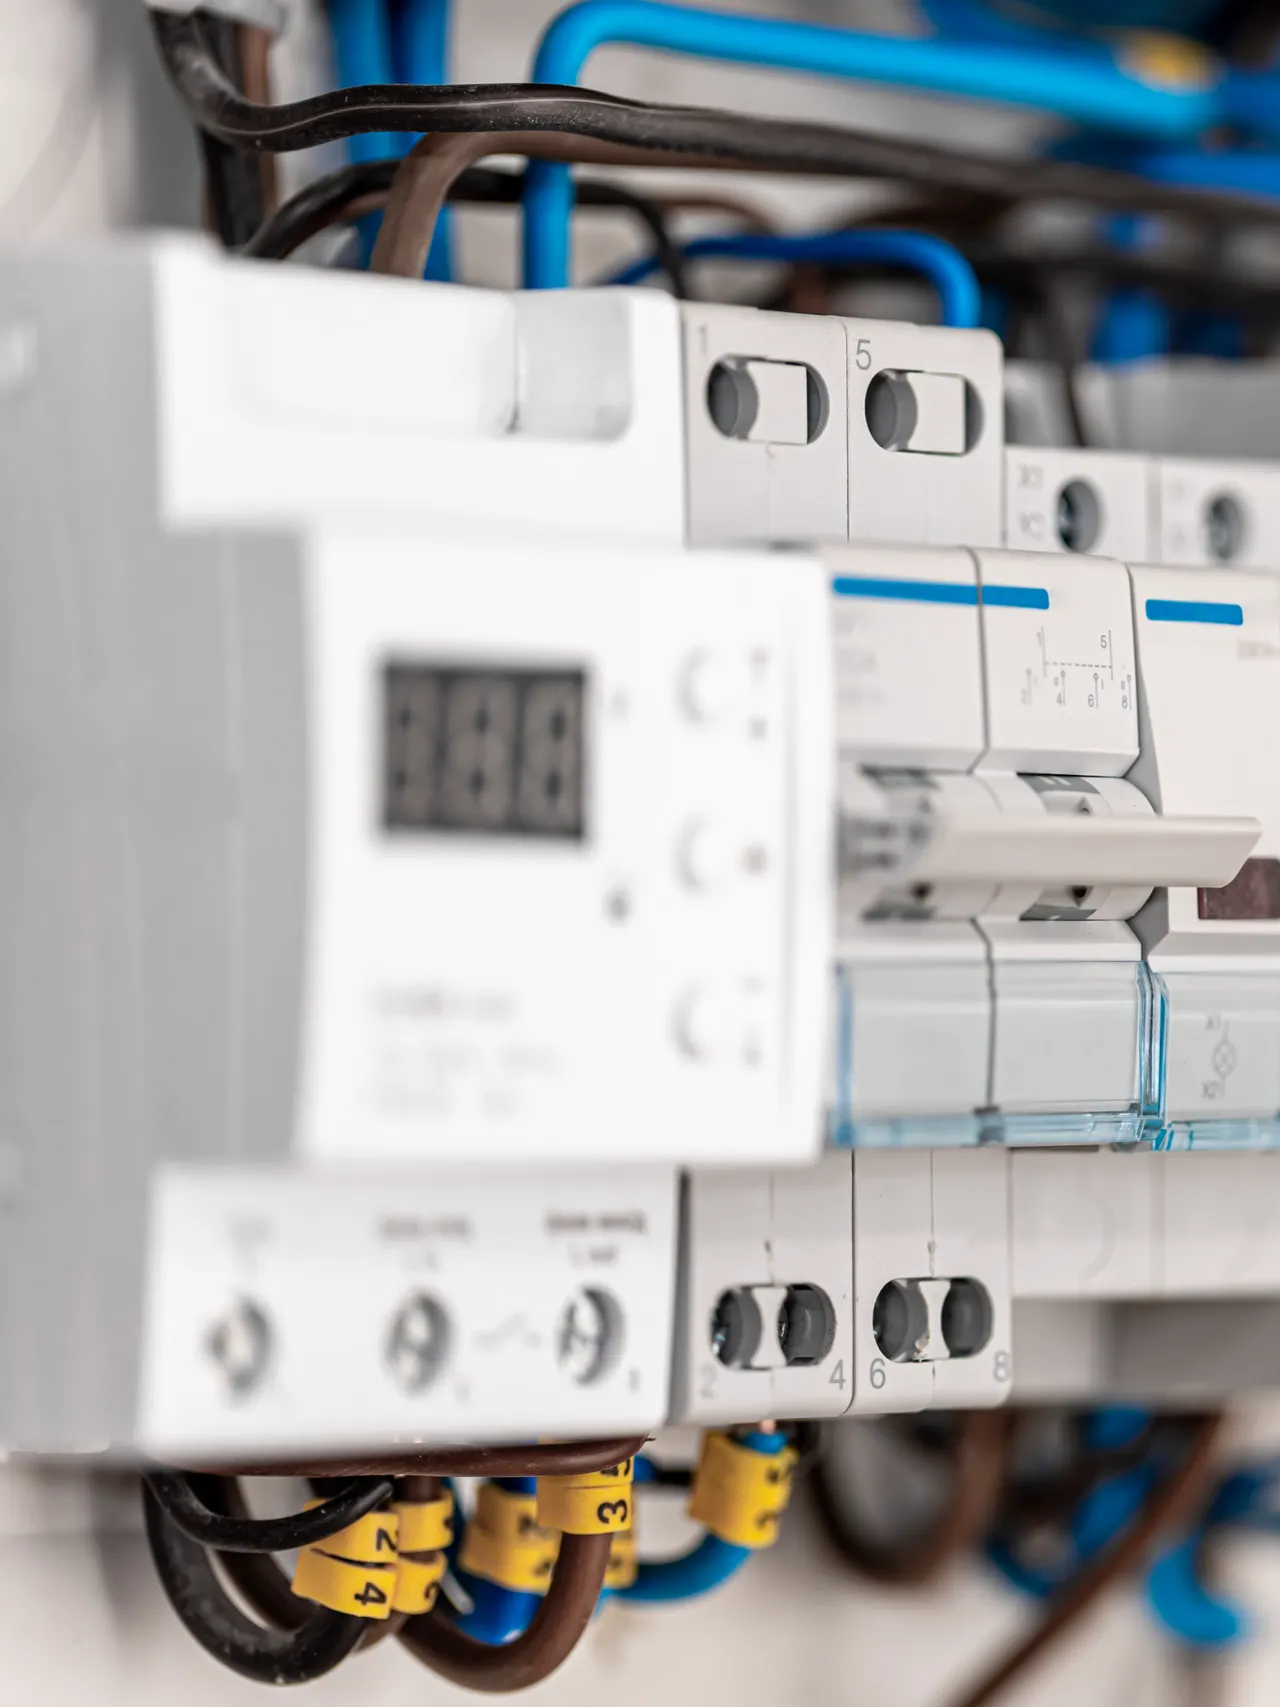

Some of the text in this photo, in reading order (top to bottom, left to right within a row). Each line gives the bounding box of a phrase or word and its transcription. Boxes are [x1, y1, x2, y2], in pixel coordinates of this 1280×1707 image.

[855, 338, 872, 371] 5
[1100, 634, 1107, 649] 5
[1087, 694, 1095, 708] 6
[1121, 695, 1128, 710] 8
[829, 1359, 847, 1390] 4
[869, 1358, 886, 1389] 6
[992, 1350, 1011, 1383] 8
[698, 1365, 718, 1399] 2
[597, 1499, 628, 1524] 3
[376, 1528, 399, 1552] 2
[354, 1582, 387, 1606] 4
